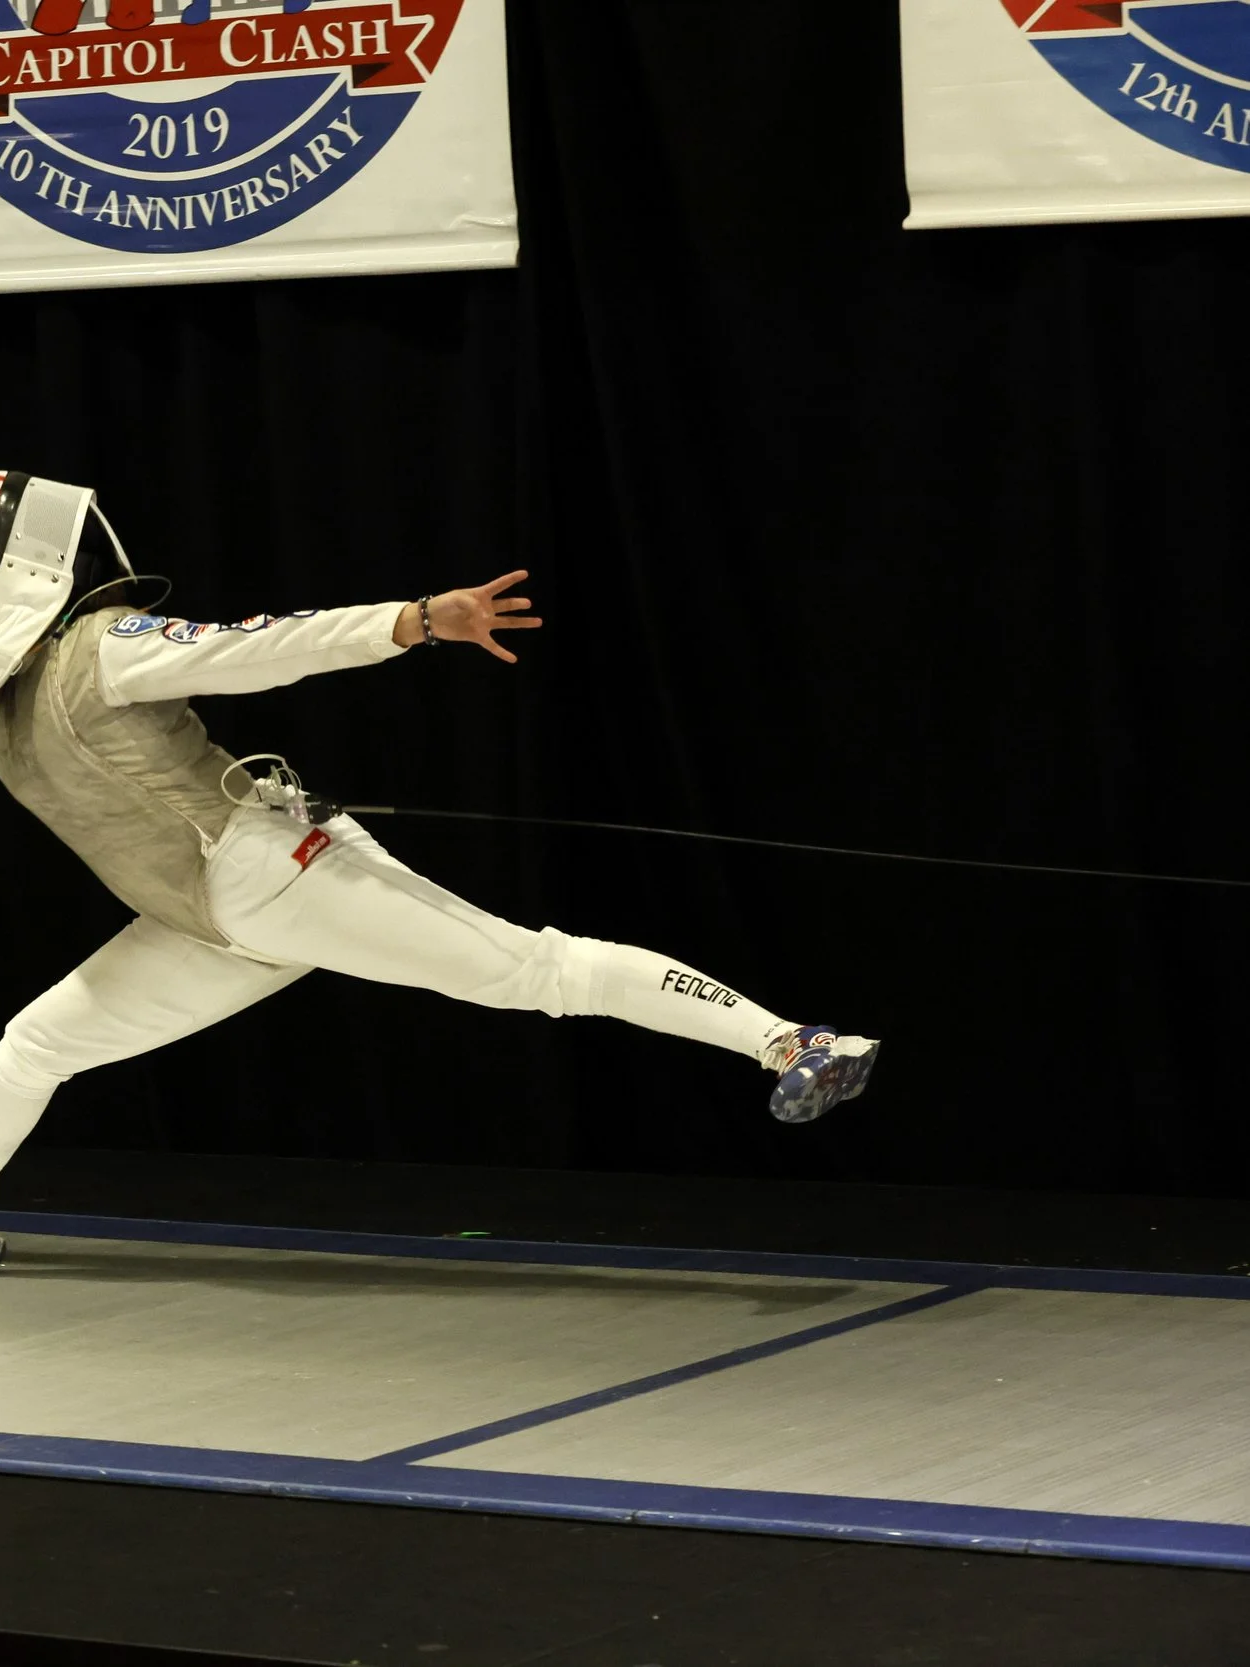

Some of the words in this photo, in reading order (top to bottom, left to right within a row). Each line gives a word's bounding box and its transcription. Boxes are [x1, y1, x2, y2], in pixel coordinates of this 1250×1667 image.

[220, 19, 392, 67] CLASH
[1118, 62, 1199, 123] 12th
[122, 106, 230, 160] 2019
[94, 105, 366, 232] ANNIVERSARY
[660, 969, 743, 1008] FENCING
